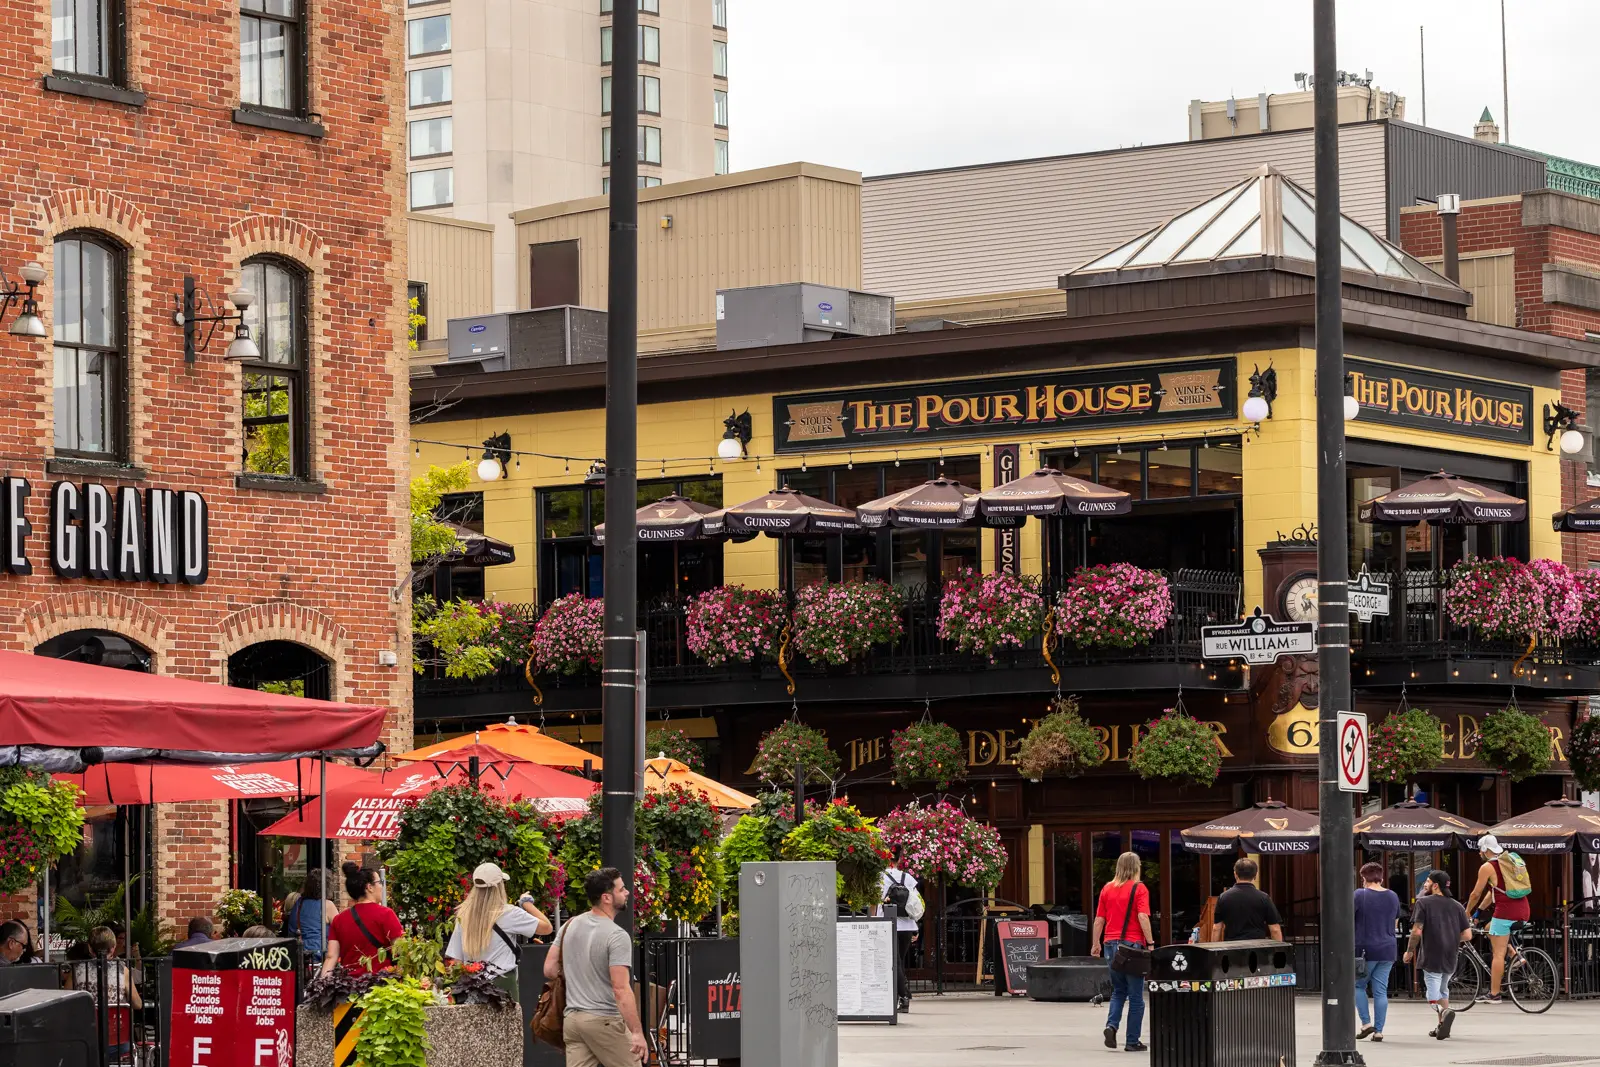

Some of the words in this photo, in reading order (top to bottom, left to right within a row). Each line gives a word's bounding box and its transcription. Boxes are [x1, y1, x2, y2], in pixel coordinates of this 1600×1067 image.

[1173, 385, 1206, 396] WINES
[1178, 394, 1212, 405] SPIRITS
[1349, 371, 1389, 409] THE
[1389, 377, 1453, 419] POUR
[1452, 387, 1524, 429] HOUSE
[849, 400, 914, 432] THE
[914, 394, 1024, 432] POUR
[1023, 384, 1153, 424] HOUSE
[800, 416, 832, 426] STOUTS
[811, 425, 832, 434] ALES
[1078, 501, 1117, 512] GUINNESS
[1473, 506, 1512, 518] GUINNESS
[744, 516, 791, 527] GUINNESS
[985, 515, 1016, 524] GUINNESS
[54, 481, 205, 580] GRAND
[638, 528, 685, 539] GUINNESS
[1354, 594, 1378, 609] GEORGE
[1216, 642, 1228, 650] RUE
[1228, 637, 1290, 651] WILLIAM
[1287, 720, 1320, 747] 6
[844, 736, 887, 771] THE
[336, 828, 367, 837] INDIA
[369, 829, 395, 838] PALE
[1258, 841, 1310, 852] GUINNESS
[1007, 943, 1029, 952] Soup
[1008, 953, 1022, 961] The
[1025, 952, 1040, 962] Day
[191, 974, 222, 985] Rentals
[252, 975, 283, 986] Rentals
[708, 972, 731, 985] wood
[192, 984, 220, 995] Homes
[253, 985, 281, 996] Homes
[190, 994, 220, 1005] Condos
[251, 995, 282, 1006] Condos
[708, 984, 741, 1013] PIZZ
[185, 1003, 224, 1015] Education
[245, 1005, 286, 1016] Education
[194, 1014, 213, 1024] Jobs
[256, 1015, 275, 1026] Jobs
